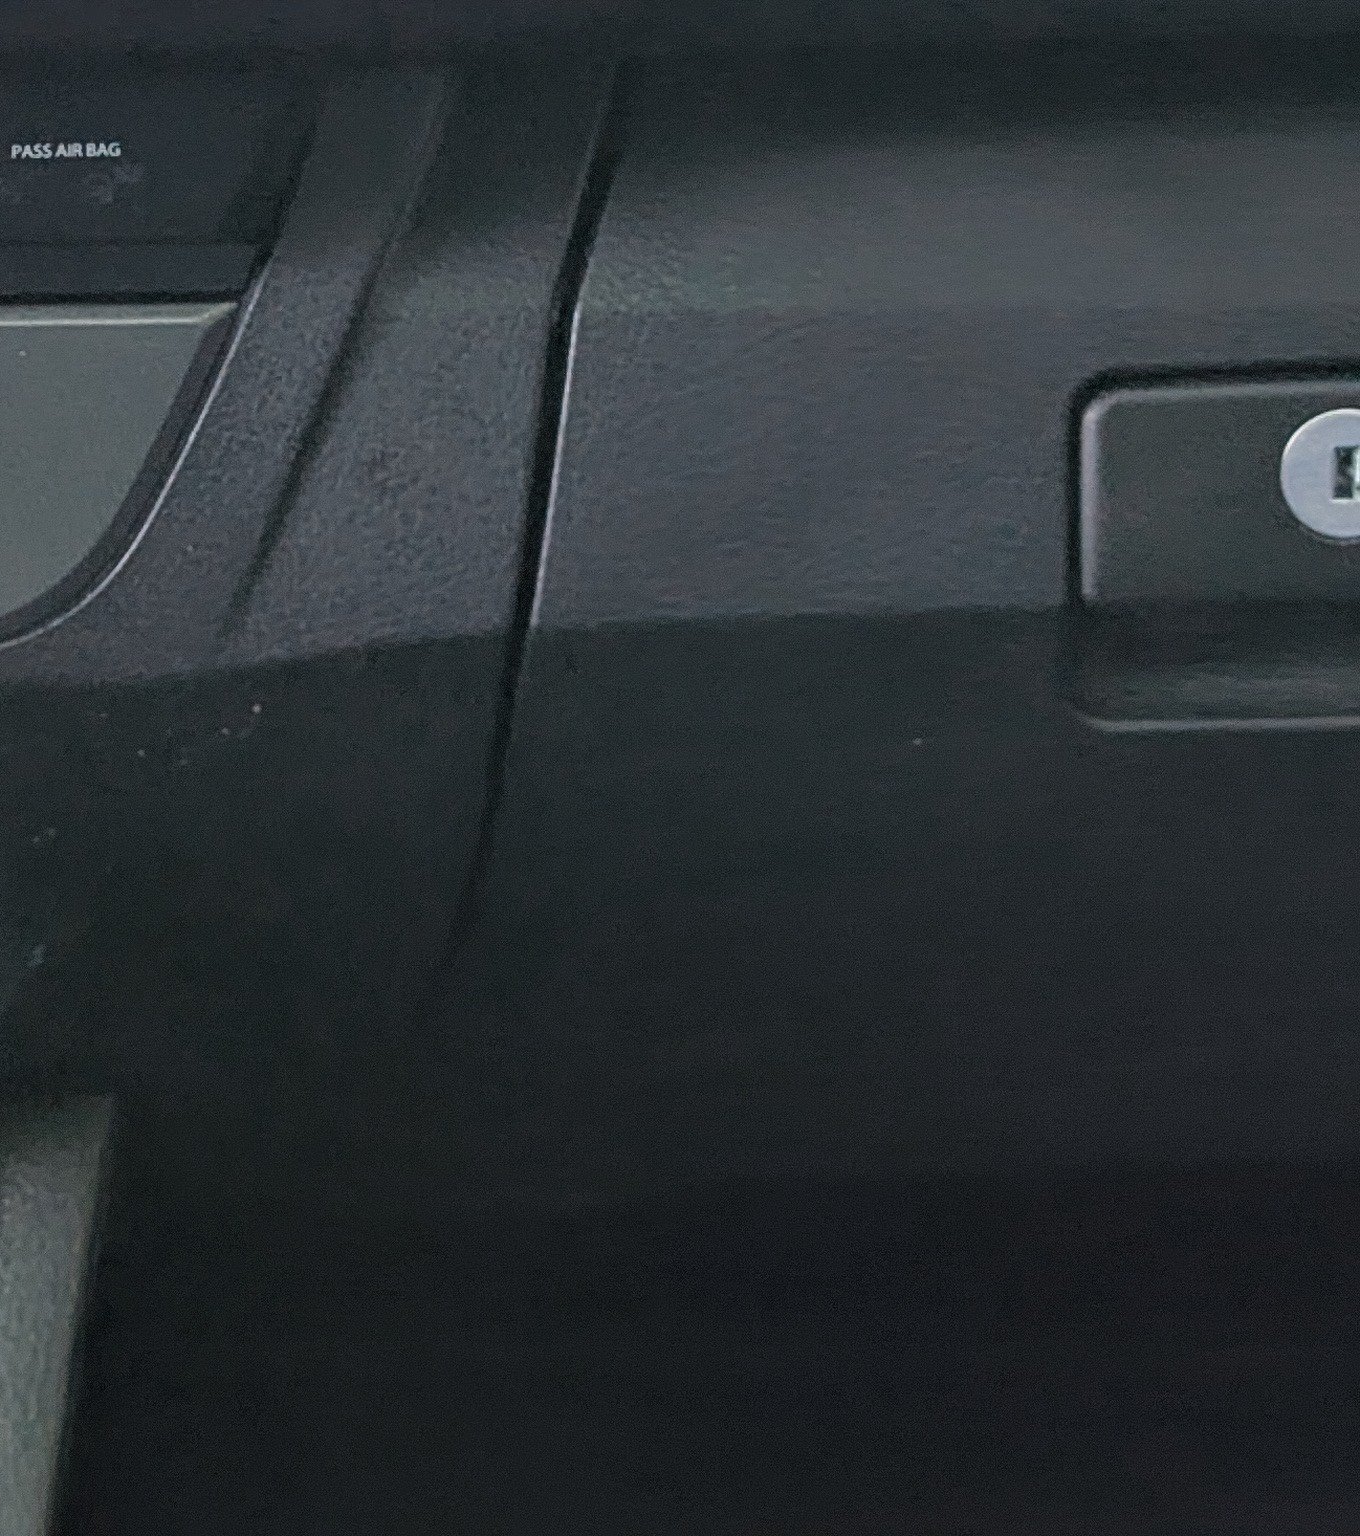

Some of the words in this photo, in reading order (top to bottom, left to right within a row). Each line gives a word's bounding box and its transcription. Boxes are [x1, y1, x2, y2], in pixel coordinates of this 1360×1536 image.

[11, 143, 52, 159] PASS
[55, 143, 83, 158] AIR
[86, 142, 122, 158] BAG
